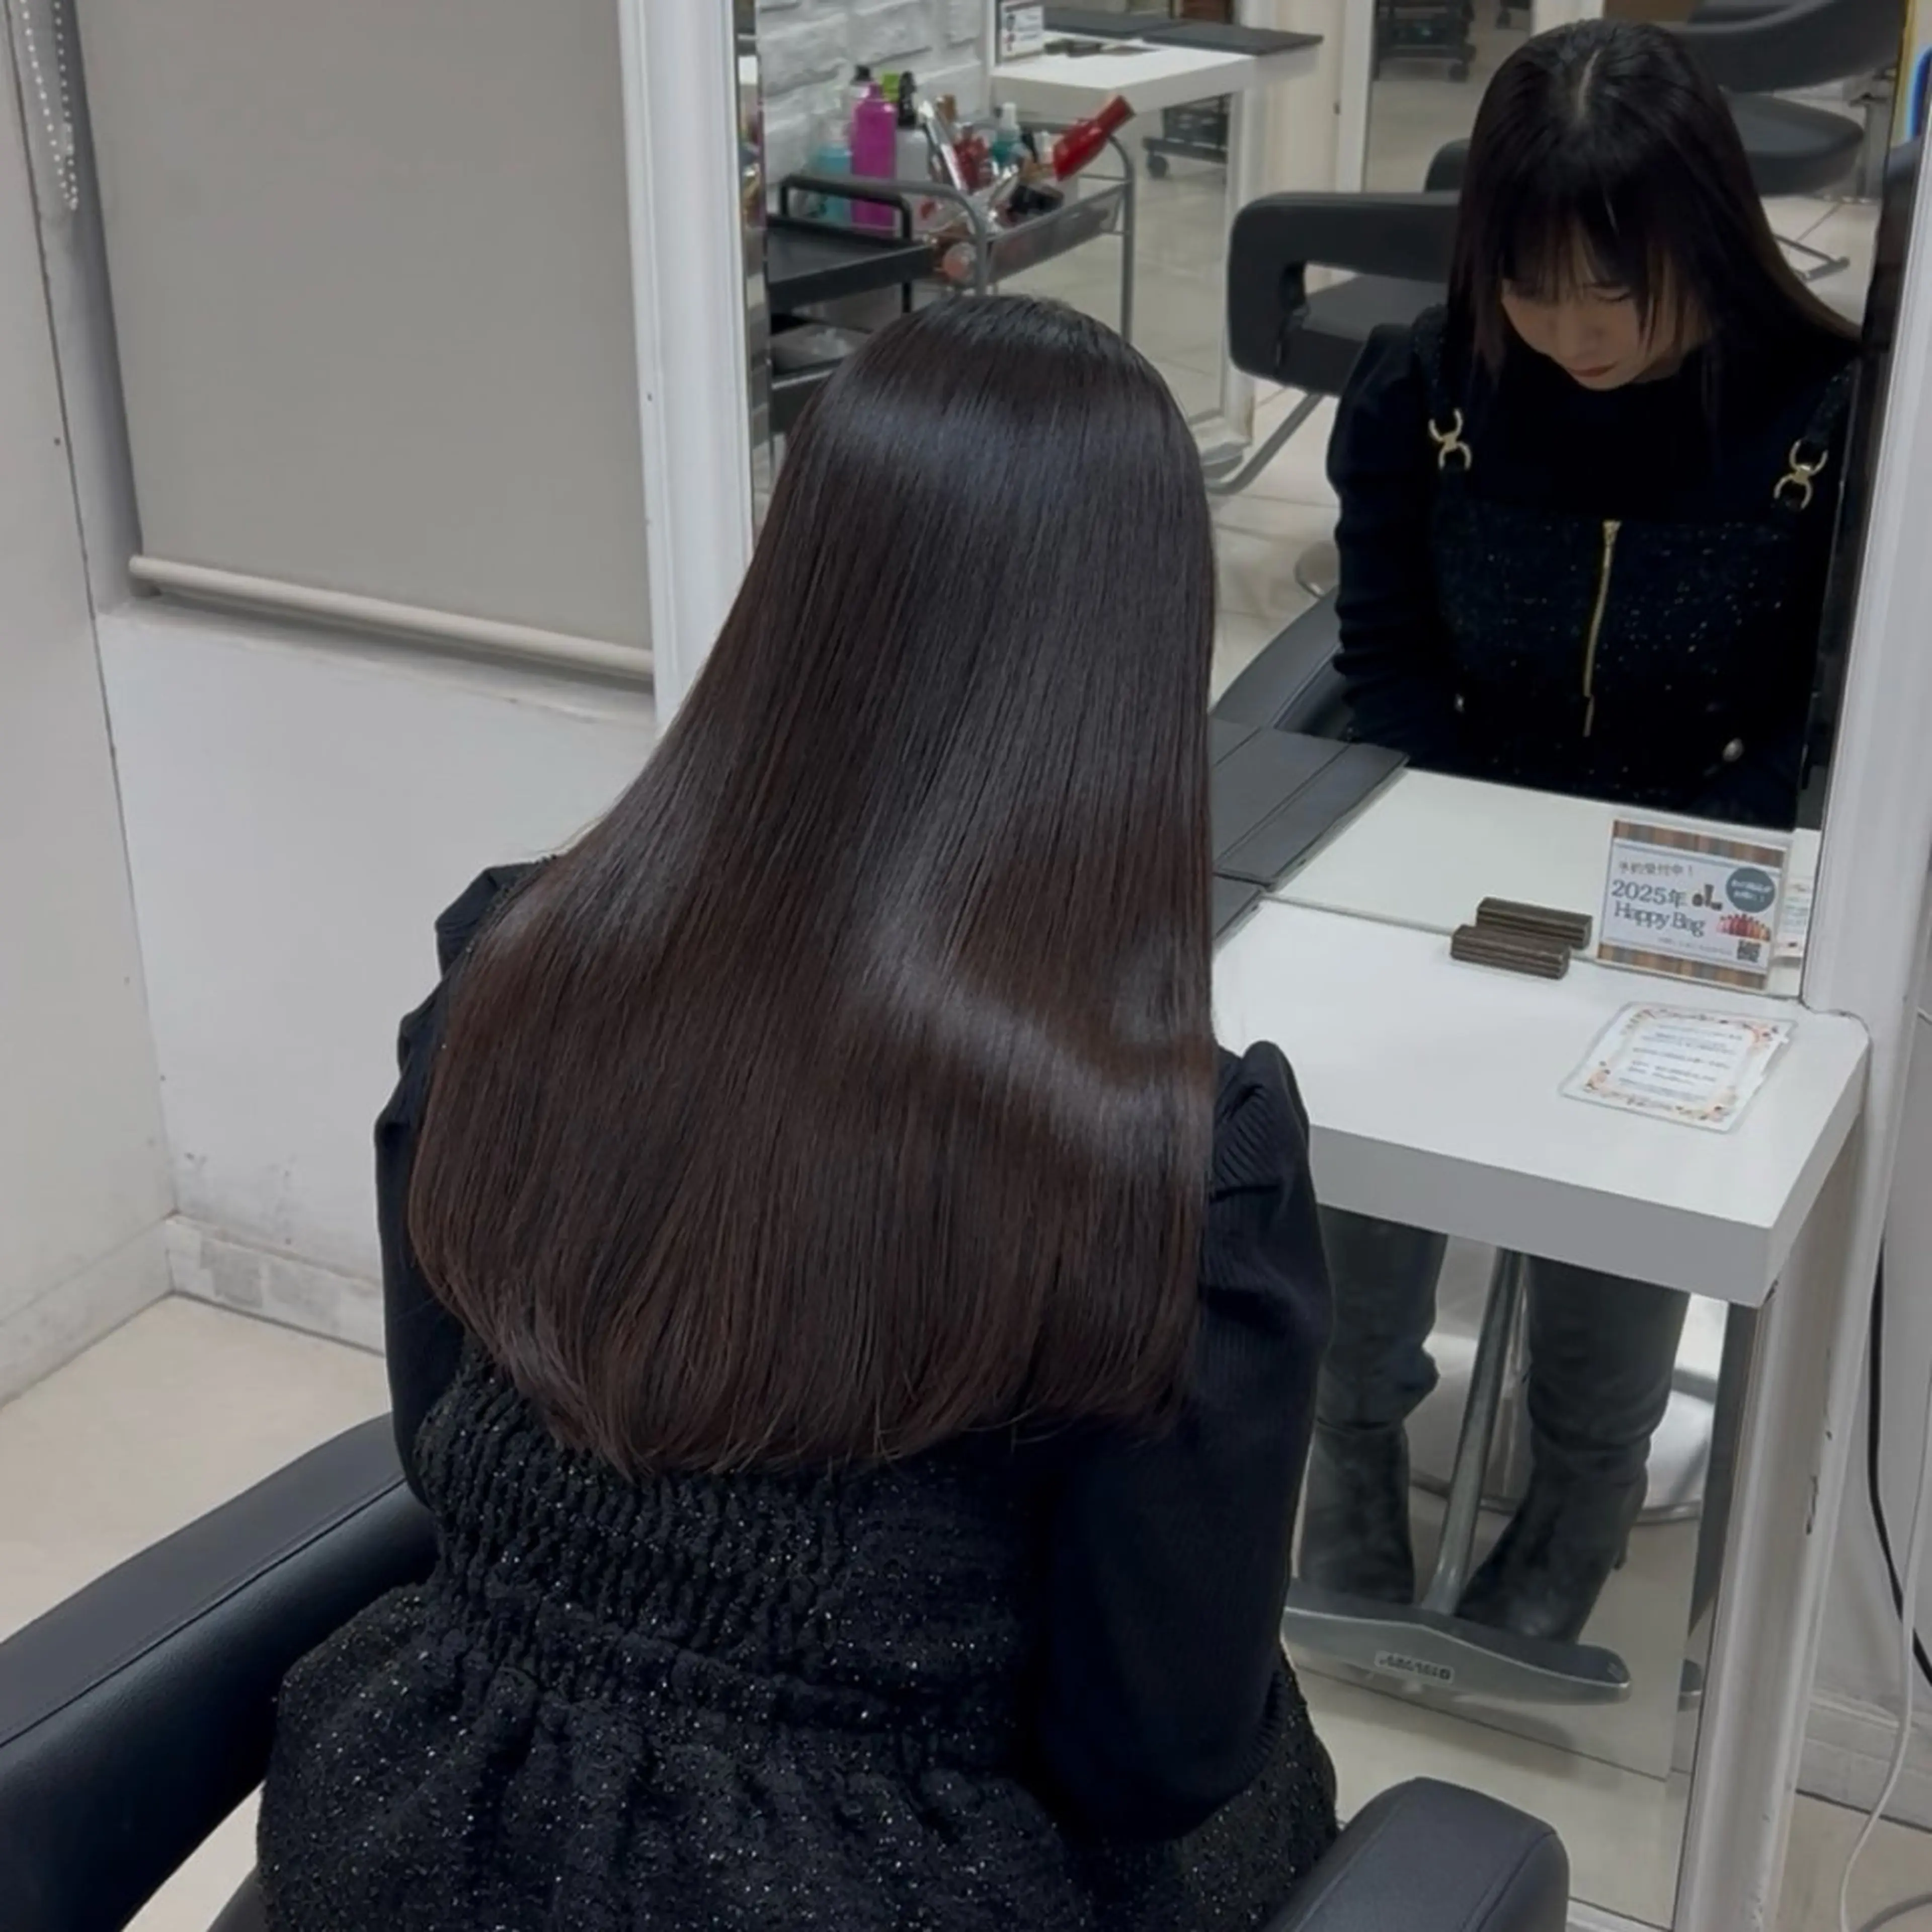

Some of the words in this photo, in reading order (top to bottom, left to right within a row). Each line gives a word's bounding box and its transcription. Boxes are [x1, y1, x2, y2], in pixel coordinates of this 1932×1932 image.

[1612, 879, 1687, 909] 2025年
[1614, 900, 1670, 930] Happy
[1670, 911, 1706, 938] Bag
